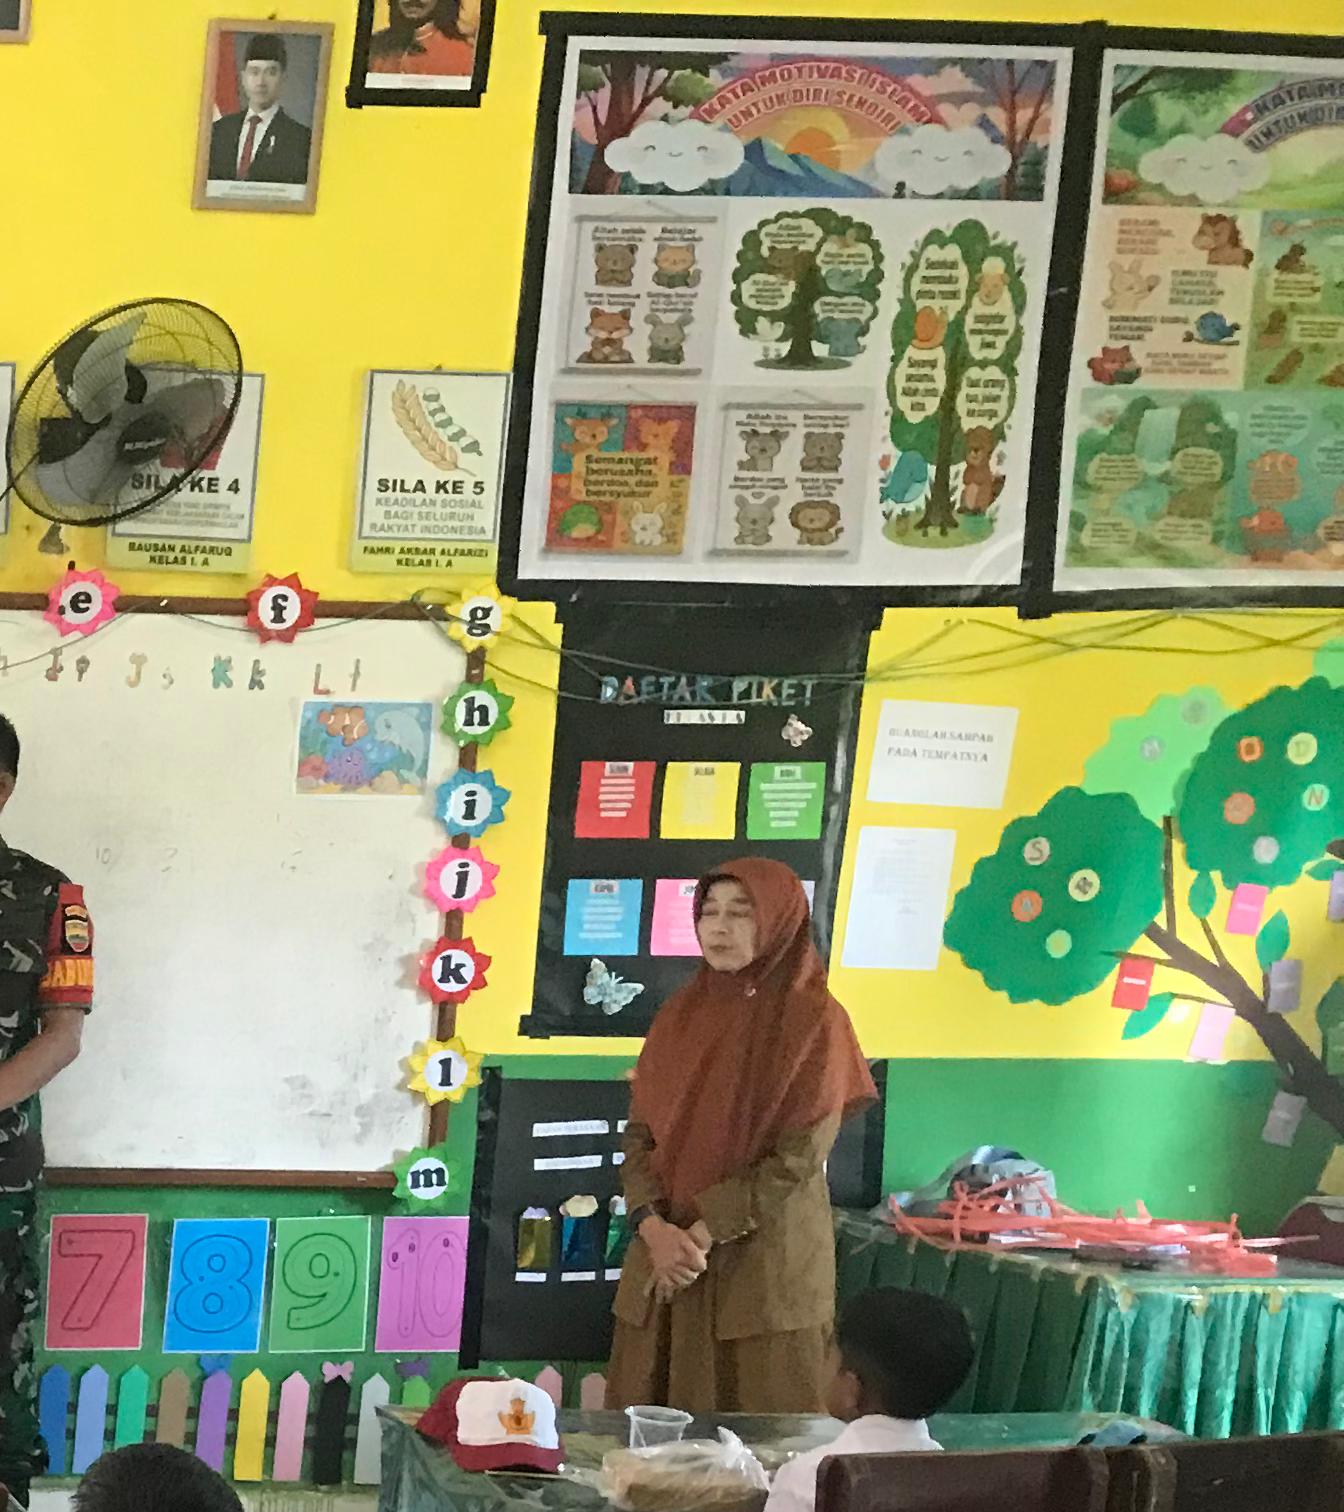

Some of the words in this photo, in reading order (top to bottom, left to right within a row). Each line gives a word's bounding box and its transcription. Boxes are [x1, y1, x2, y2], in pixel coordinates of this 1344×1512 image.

[700, 78, 755, 120] KATA
[757, 64, 861, 90] MOTIVASI
[727, 93, 787, 129] UNTUK
[792, 88, 828, 103] DIRI
[836, 89, 902, 132] SENDIRI
[132, 473, 181, 493] SILA
[189, 477, 219, 493] KE
[227, 479, 240, 494] 4
[377, 478, 426, 493] SILA
[435, 480, 464, 494] KE
[473, 481, 485, 495] 5
[375, 497, 436, 507] KEADILAN
[441, 499, 483, 509] SOSIAL
[384, 510, 412, 520] BAGI
[418, 511, 475, 521] SELURUH
[370, 523, 417, 533] RAKYAT
[420, 525, 486, 535] INDONESIA
[70, 589, 91, 613] e
[269, 595, 288, 624] f
[467, 605, 493, 634] g
[600, 675, 716, 705] DAFTAR
[732, 676, 819, 706] PIKET
[463, 697, 490, 727] h
[888, 747, 917, 757] PADA
[461, 791, 477, 820] i
[453, 863, 470, 898] j
[438, 956, 467, 984] k
[410, 1168, 447, 1189] m
[58, 1229, 136, 1331] 7
[173, 1234, 253, 1334] 8
[282, 1232, 358, 1330] 9
[386, 1227, 469, 1338] 10
